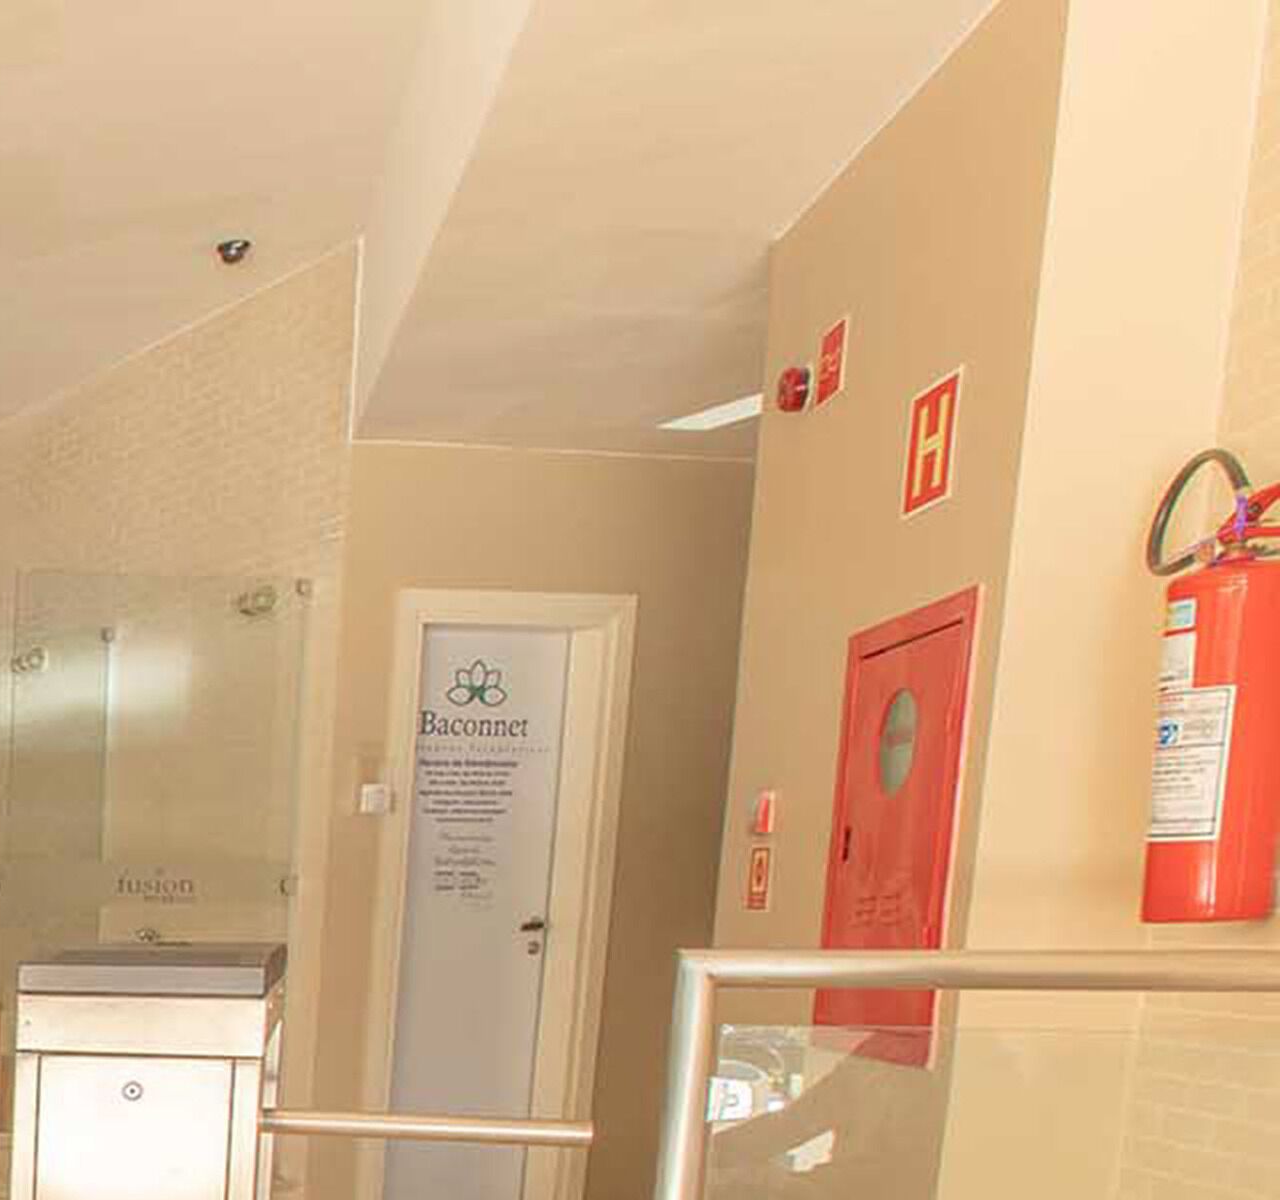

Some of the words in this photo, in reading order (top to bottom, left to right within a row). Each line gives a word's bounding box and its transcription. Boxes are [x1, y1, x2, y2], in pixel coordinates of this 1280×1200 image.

[912, 392, 951, 499] H
[420, 709, 528, 738] Baconnet
[117, 868, 194, 894] fusion
